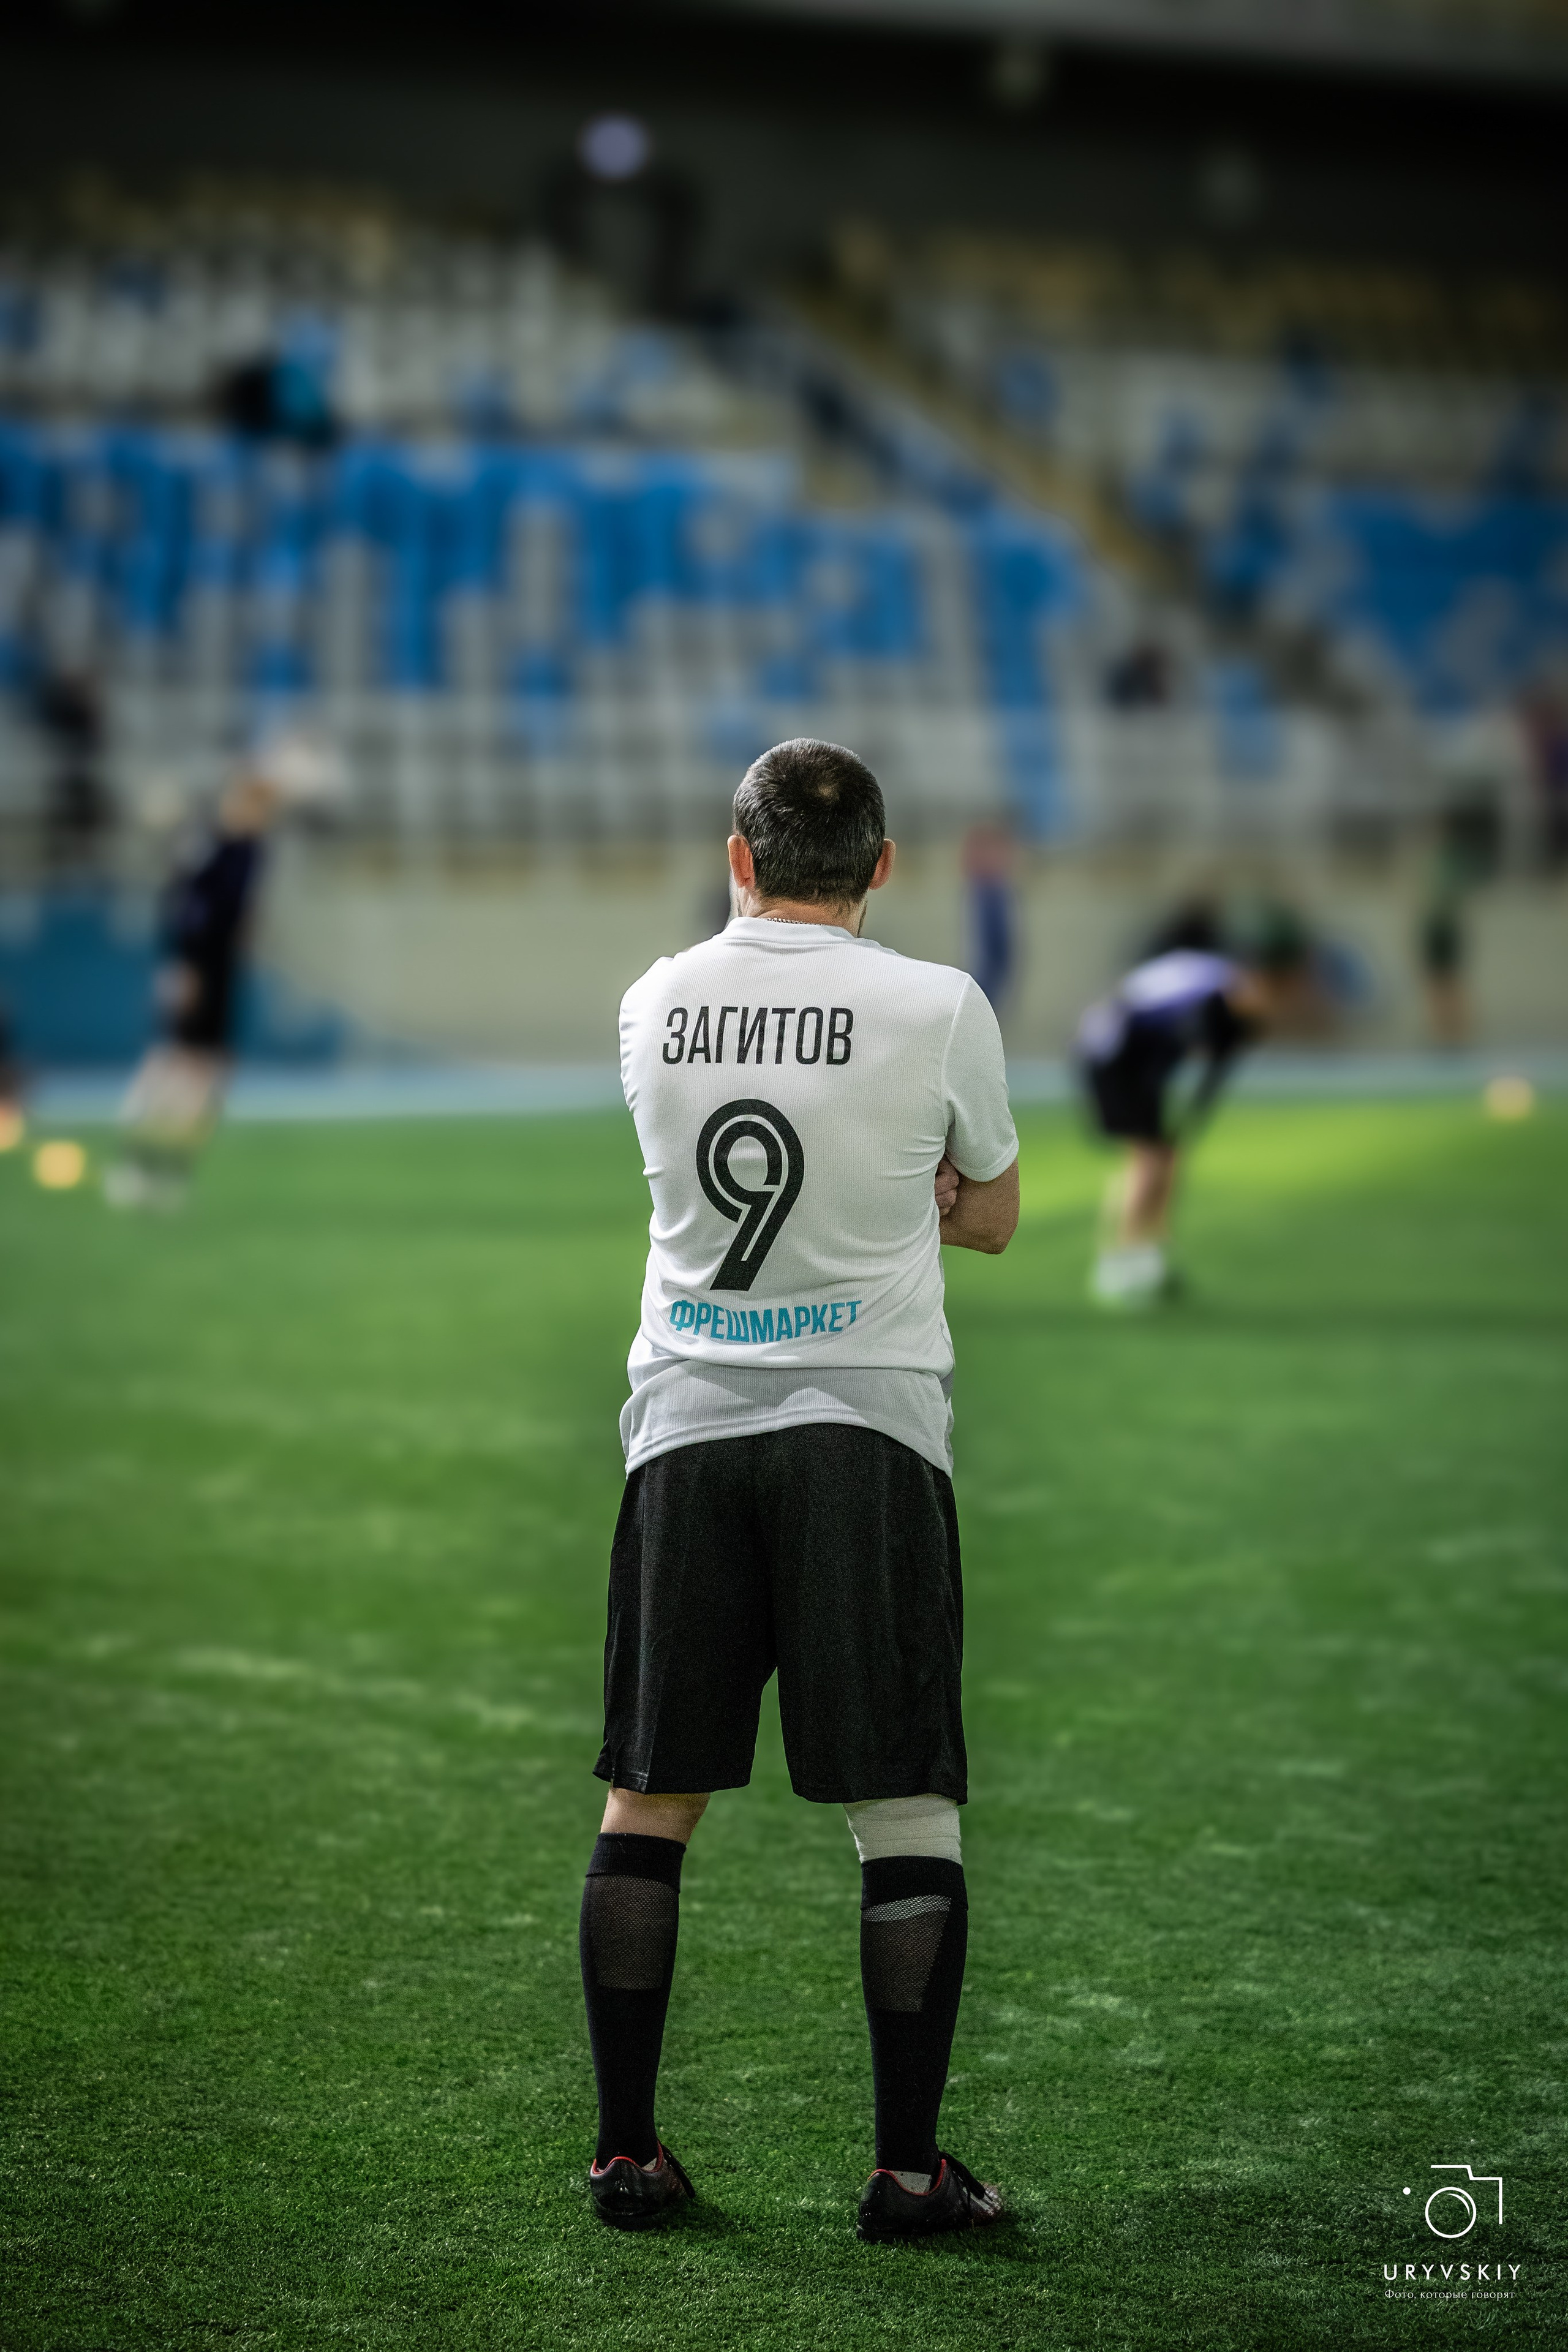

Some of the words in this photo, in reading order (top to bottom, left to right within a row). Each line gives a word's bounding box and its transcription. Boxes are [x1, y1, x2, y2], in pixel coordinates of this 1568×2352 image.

[662, 1006, 854, 1065] ЗАГИТОВ
[696, 1098, 805, 1292] 9
[669, 1300, 862, 1343] ФРЕШМАРКЕТ
